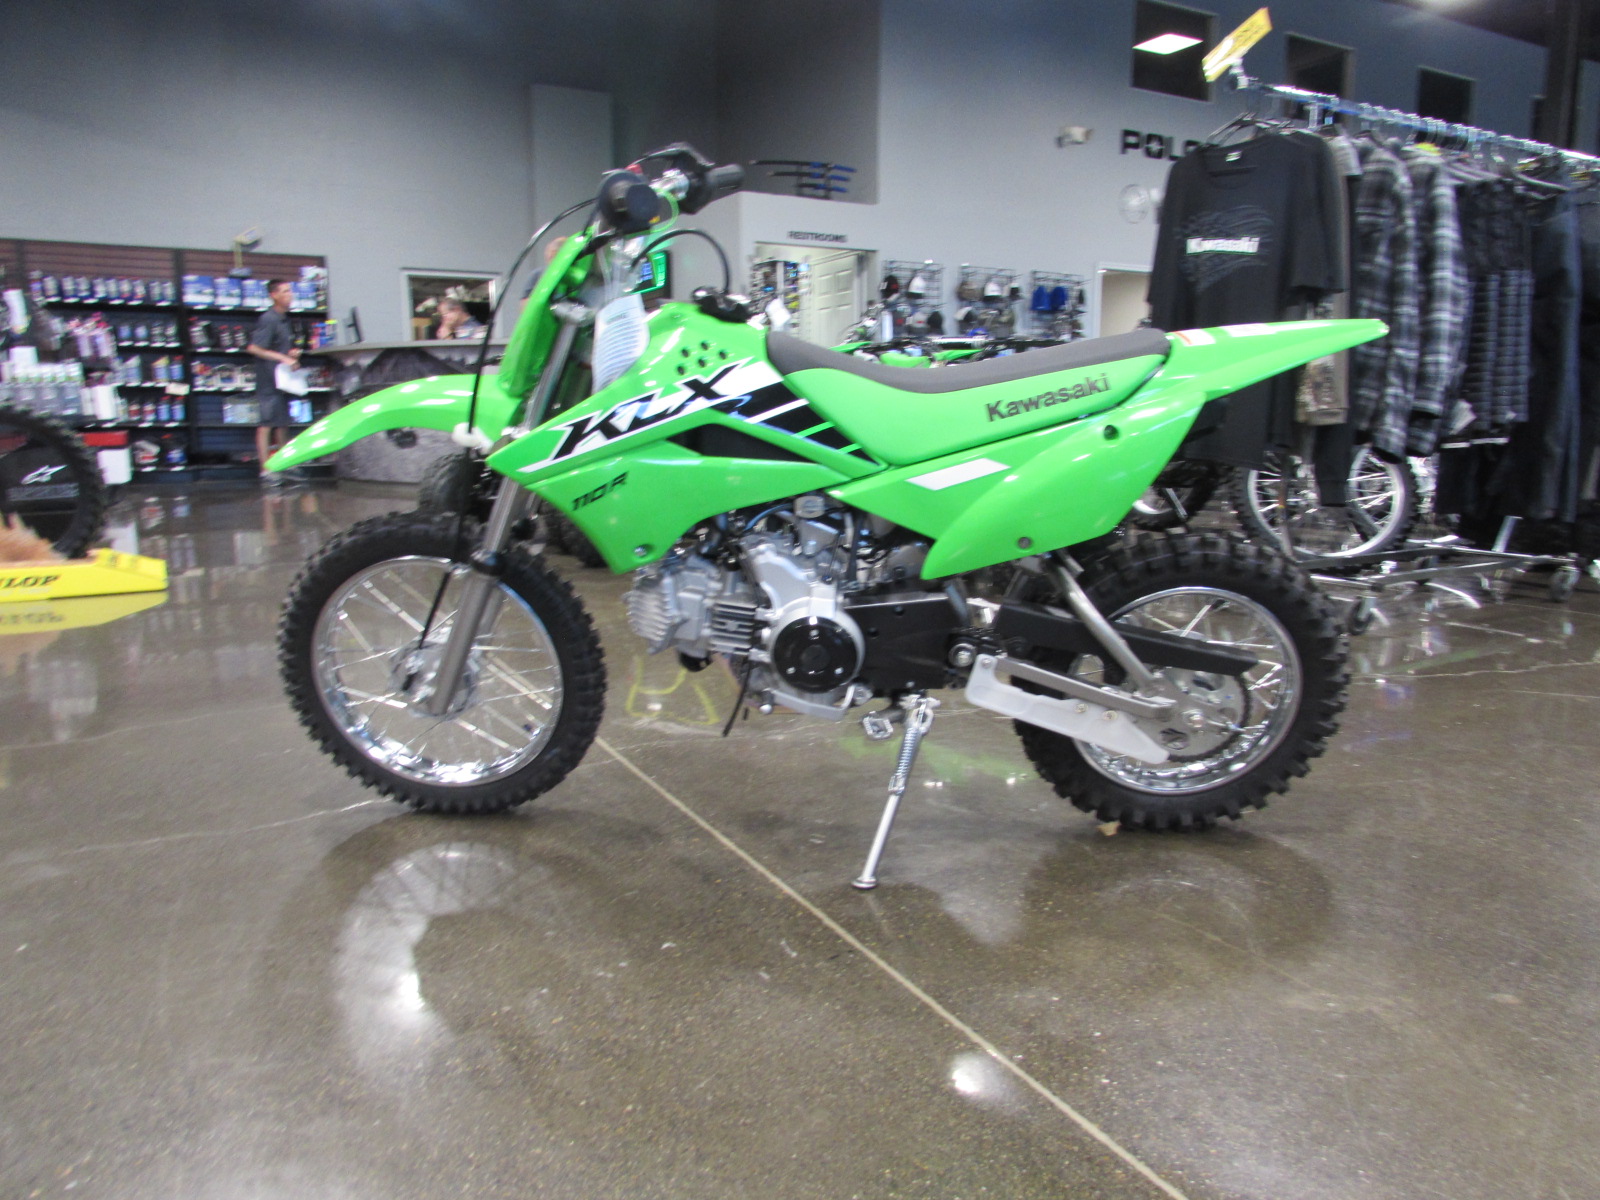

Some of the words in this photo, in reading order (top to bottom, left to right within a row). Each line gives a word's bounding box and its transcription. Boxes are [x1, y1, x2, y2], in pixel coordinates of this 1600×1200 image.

[548, 361, 746, 461] KLX
[985, 373, 1111, 421] Kawasaki
[0, 575, 60, 588] LOP
